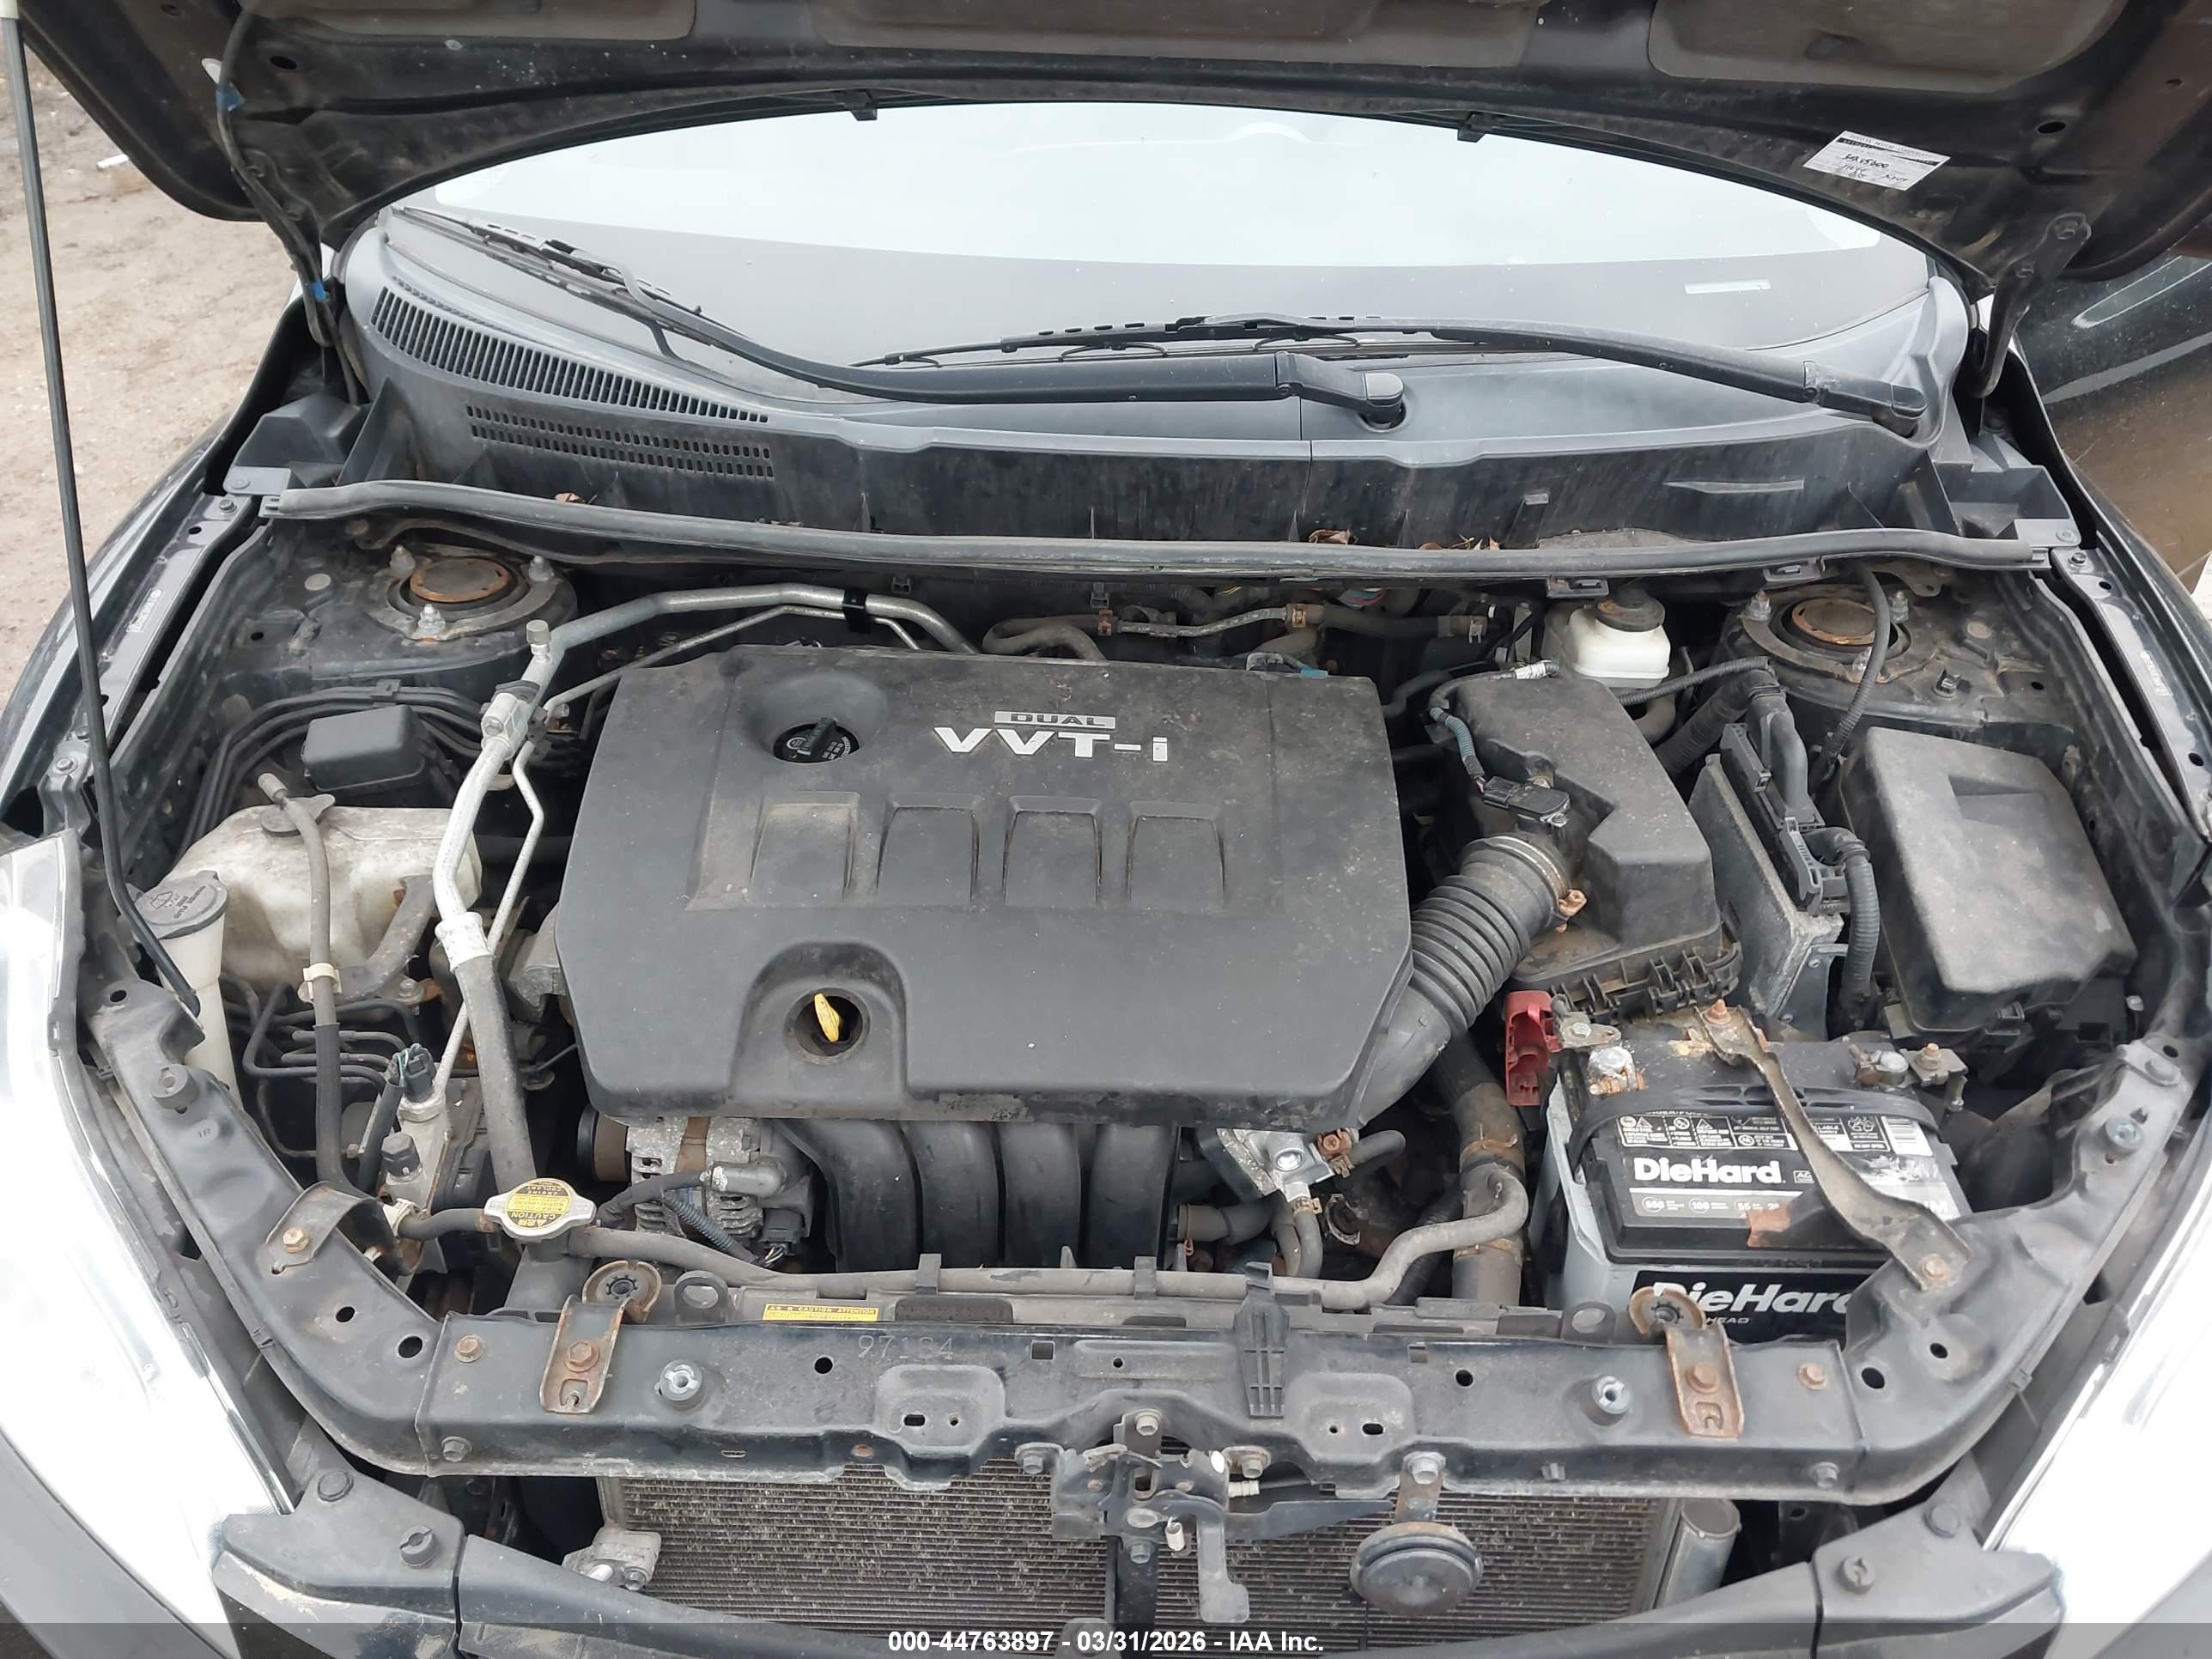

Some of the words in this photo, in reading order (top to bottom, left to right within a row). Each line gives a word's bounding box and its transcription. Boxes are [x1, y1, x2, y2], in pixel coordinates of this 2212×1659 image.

[1010, 713, 1106, 726] DUAL
[933, 726, 1169, 763] VVT-i
[1633, 1157, 1783, 1184] DieHard
[511, 1211, 556, 1219] CAUTION
